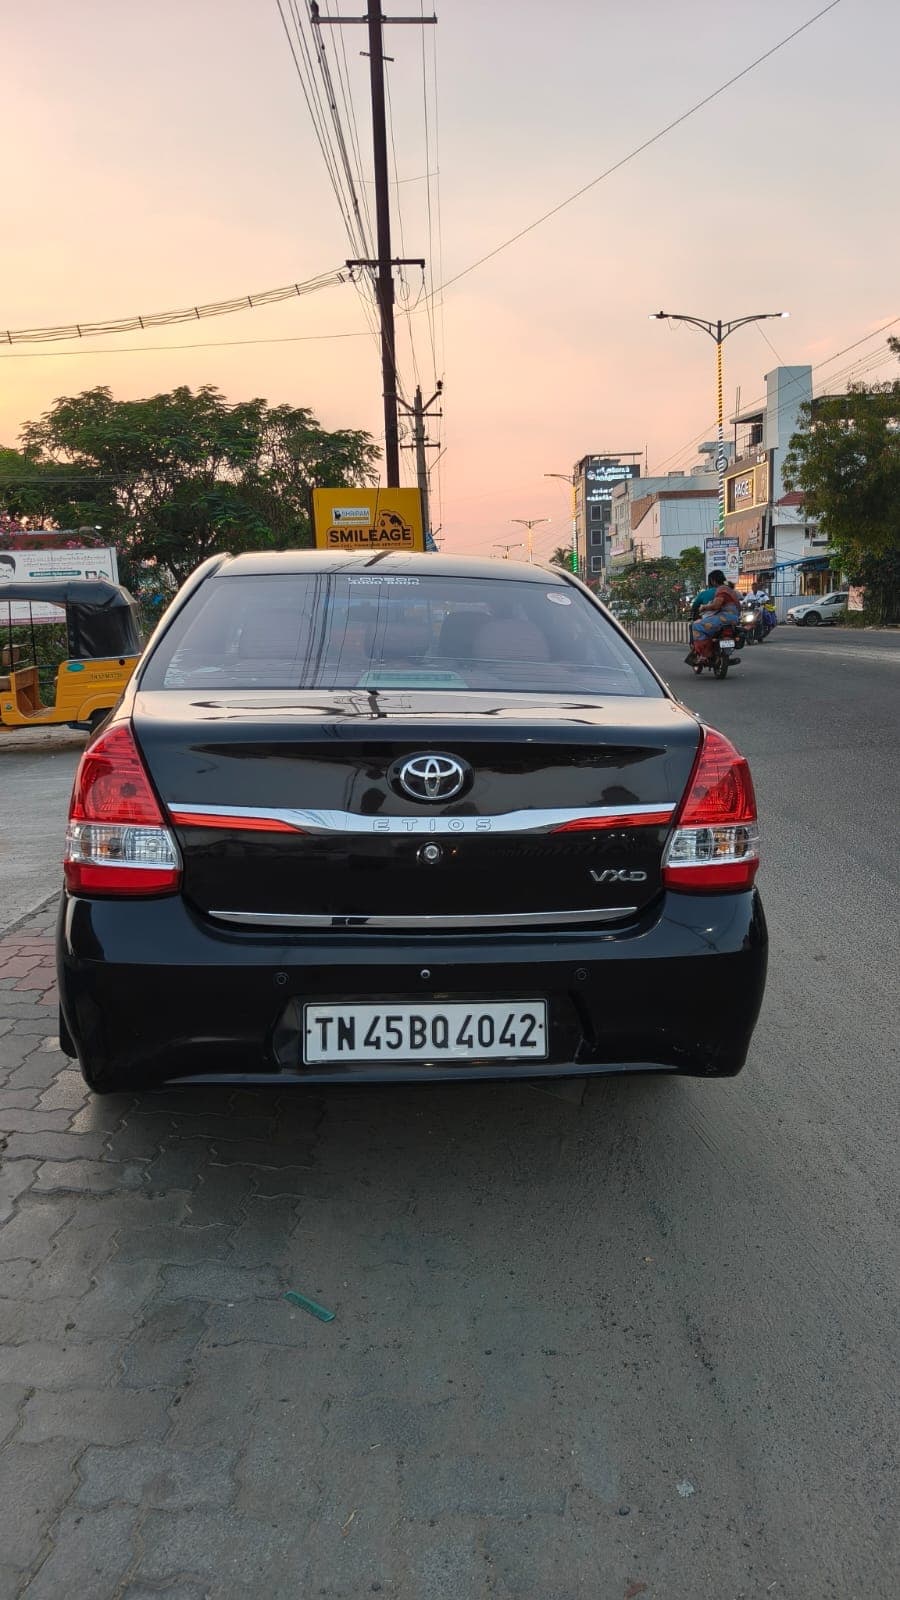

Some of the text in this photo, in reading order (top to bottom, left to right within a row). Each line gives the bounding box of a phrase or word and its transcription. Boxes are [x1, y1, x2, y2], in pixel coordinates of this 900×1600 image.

[330, 529, 411, 542] SMILEAGE
[372, 817, 492, 832] ETIOS
[589, 869, 648, 882] VXD
